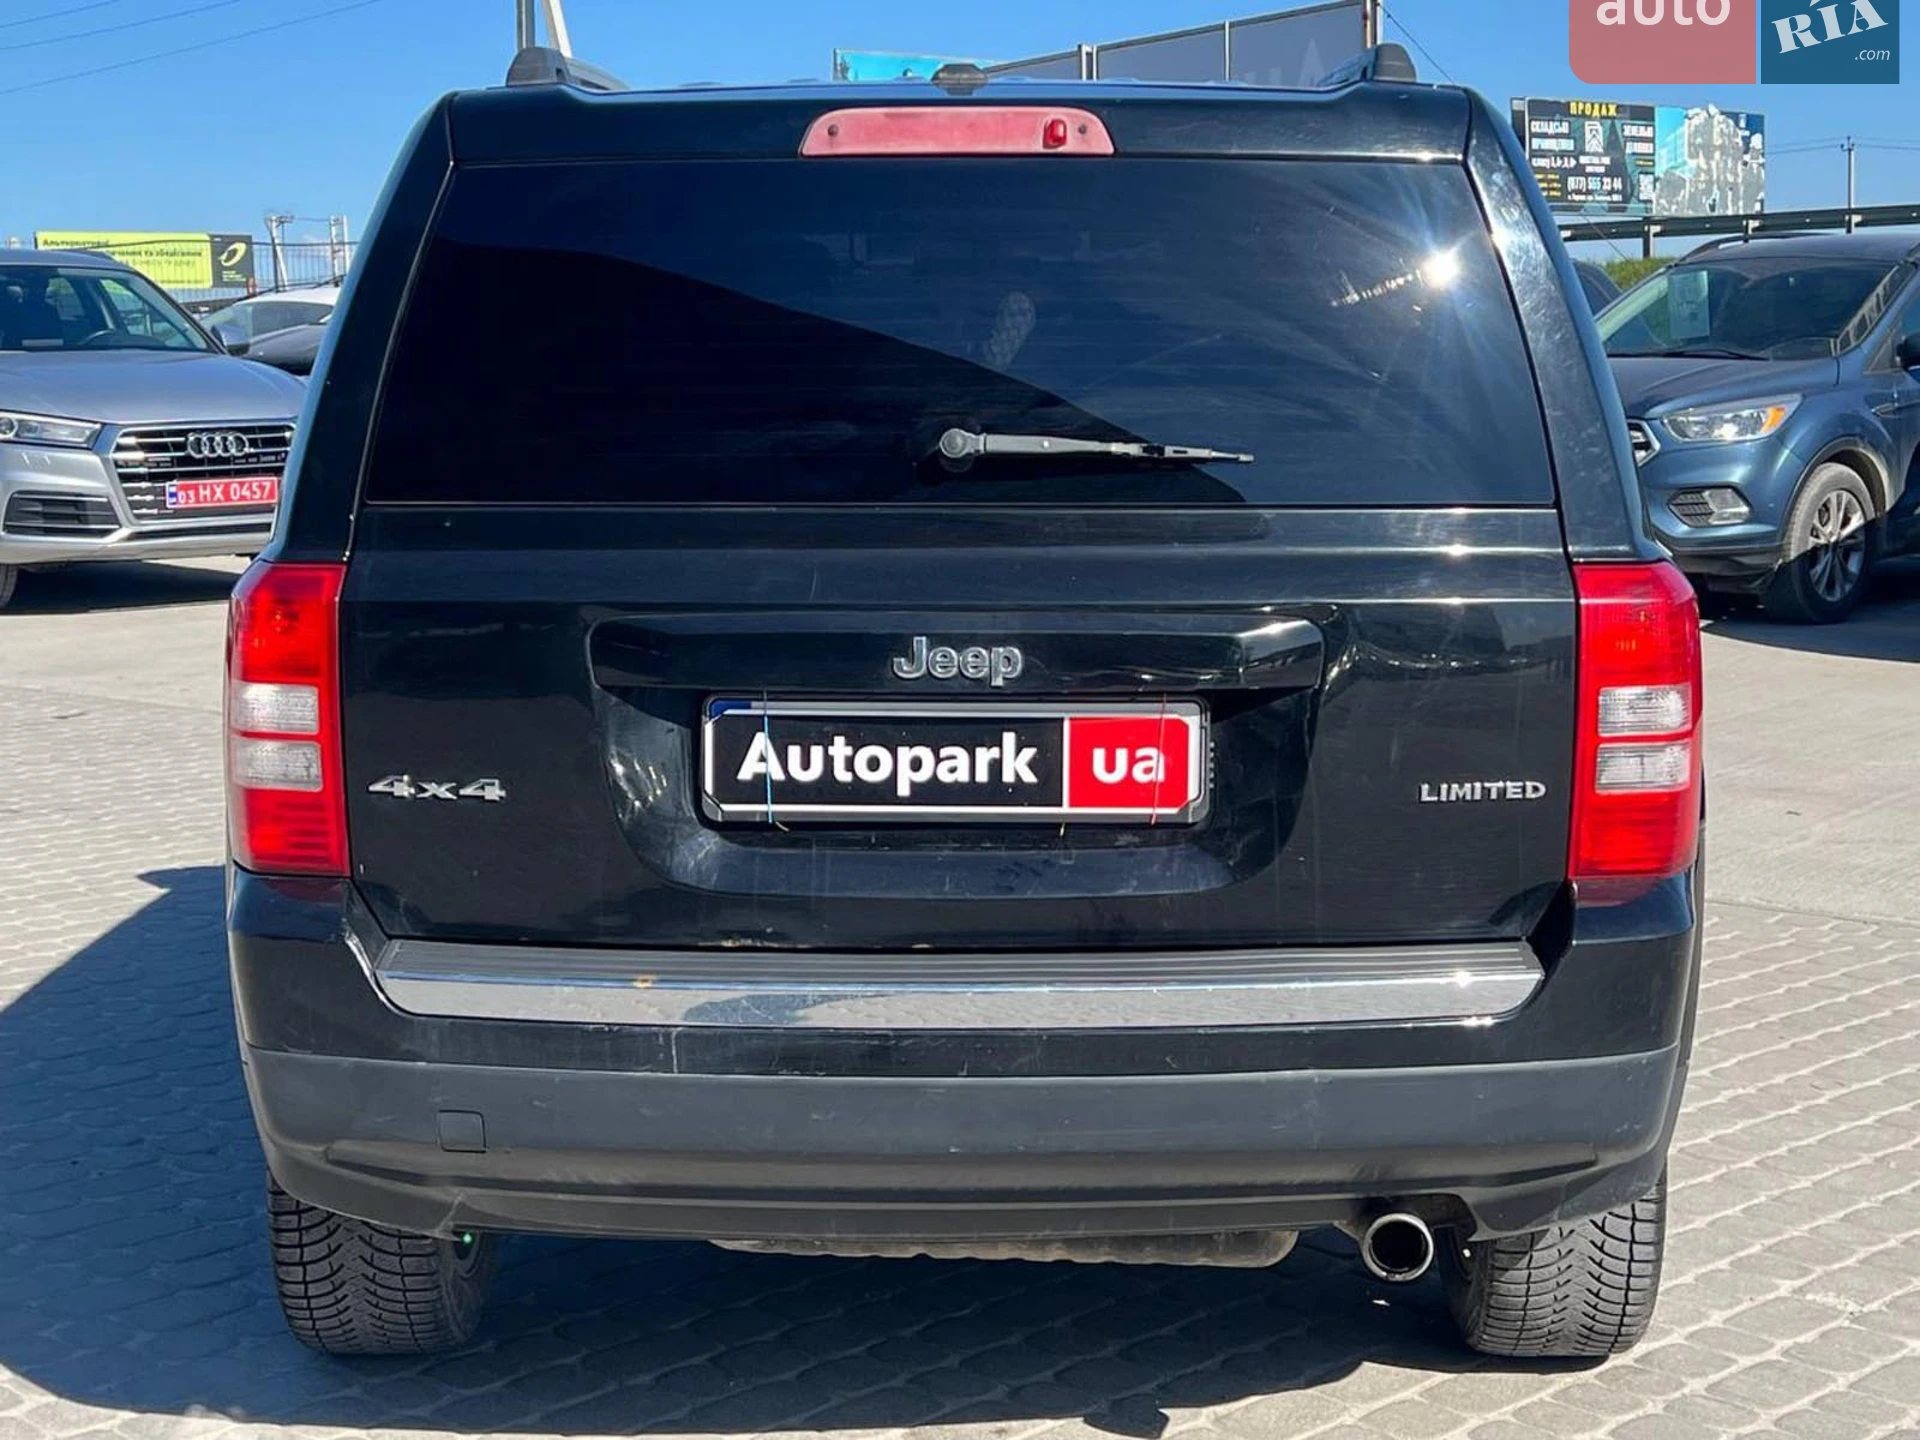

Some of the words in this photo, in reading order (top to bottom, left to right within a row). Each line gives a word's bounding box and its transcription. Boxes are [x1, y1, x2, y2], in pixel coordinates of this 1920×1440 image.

[1570, 102, 1616, 117] ПРОДАЖ
[178, 491, 195, 504] 03
[199, 485, 225, 501] HX
[230, 481, 270, 500] 0457
[892, 636, 1023, 687] Jeep
[737, 731, 1038, 797] Autopark
[1092, 746, 1166, 784] ua
[1419, 780, 1547, 803] LIMITED
